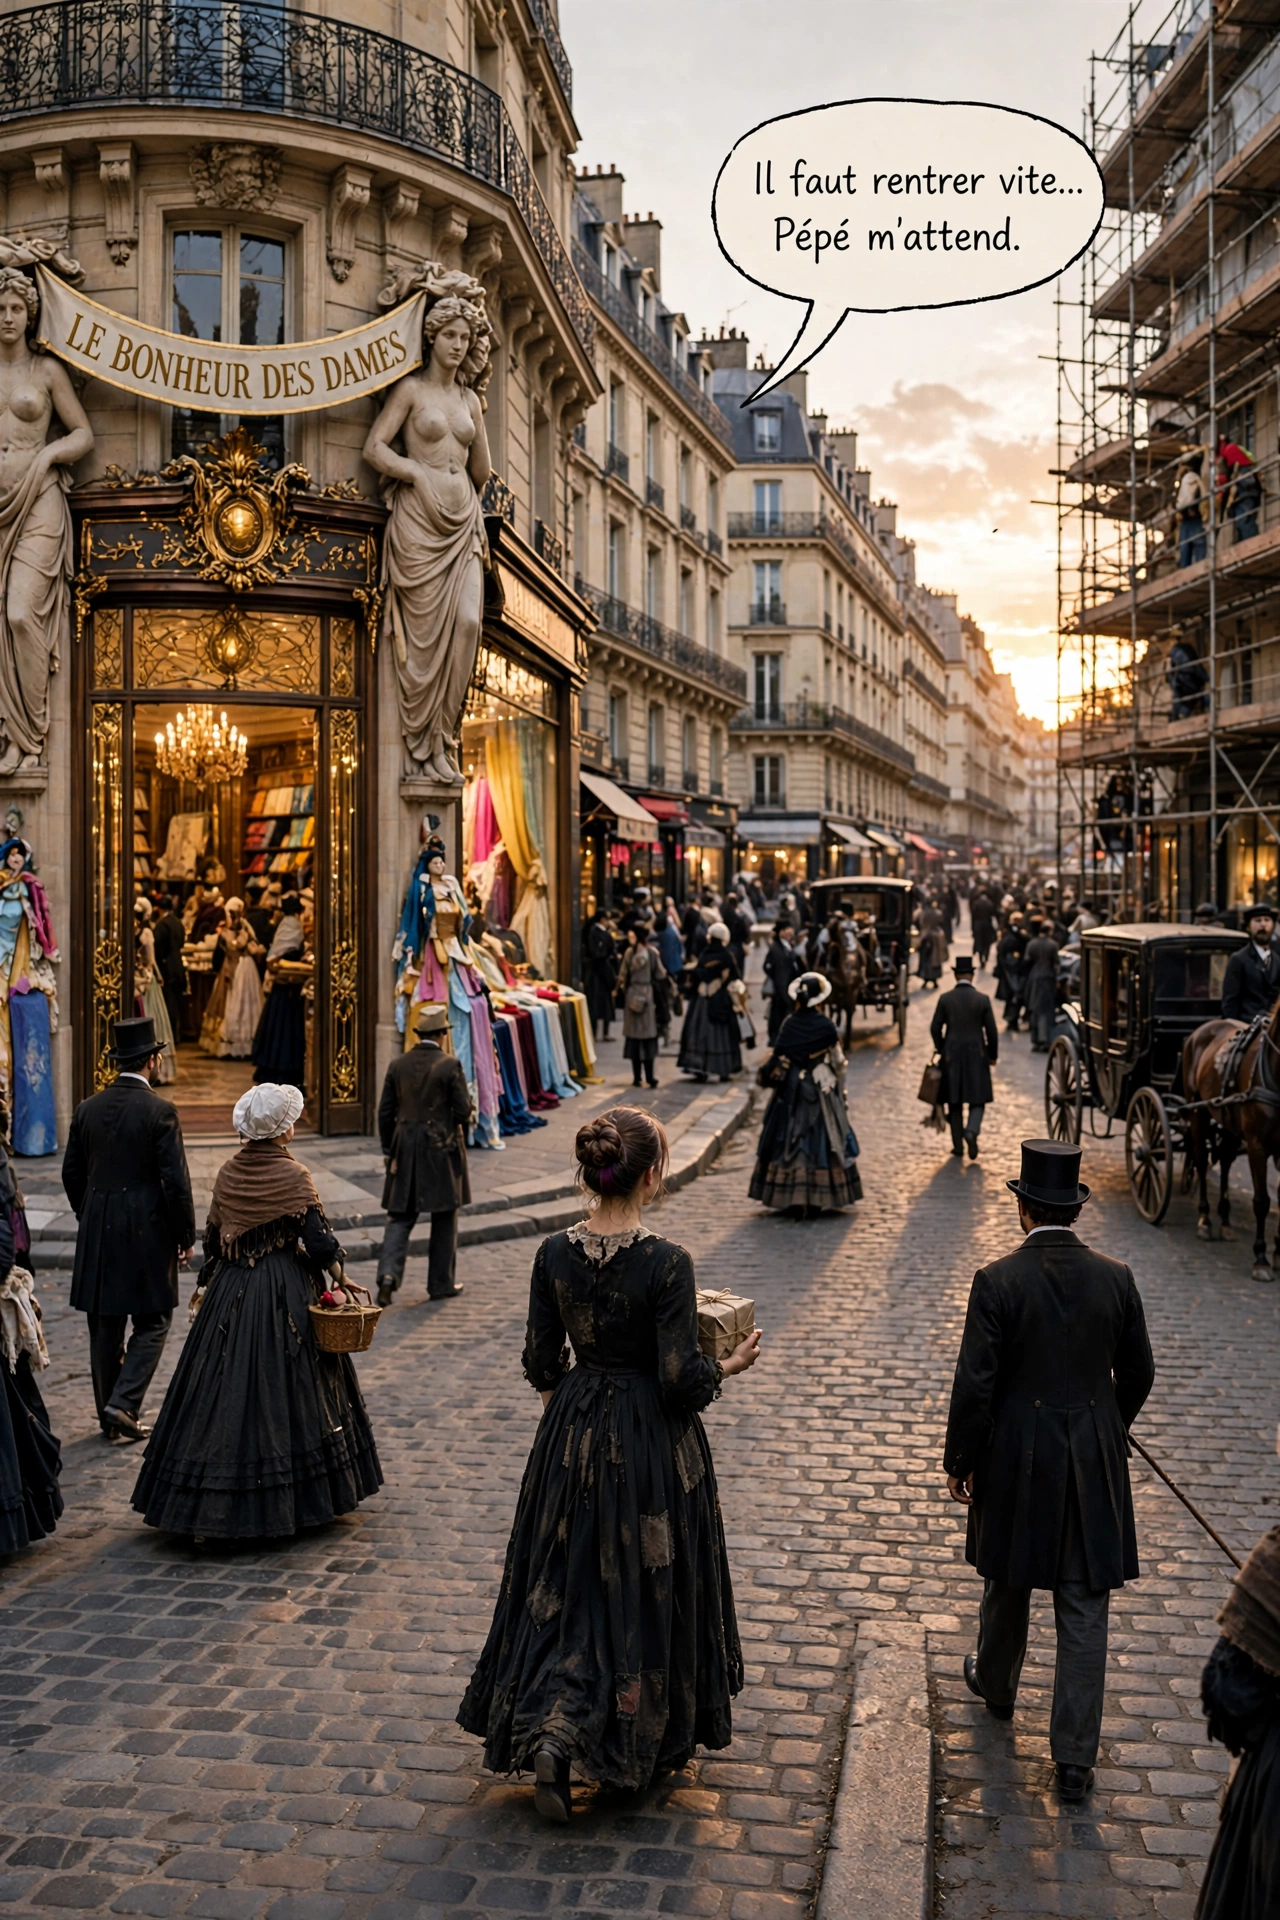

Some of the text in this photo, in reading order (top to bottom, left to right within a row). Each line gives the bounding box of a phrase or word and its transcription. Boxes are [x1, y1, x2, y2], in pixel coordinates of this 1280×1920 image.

[65, 312, 408, 400] LE BONHEUR DES DAMES
